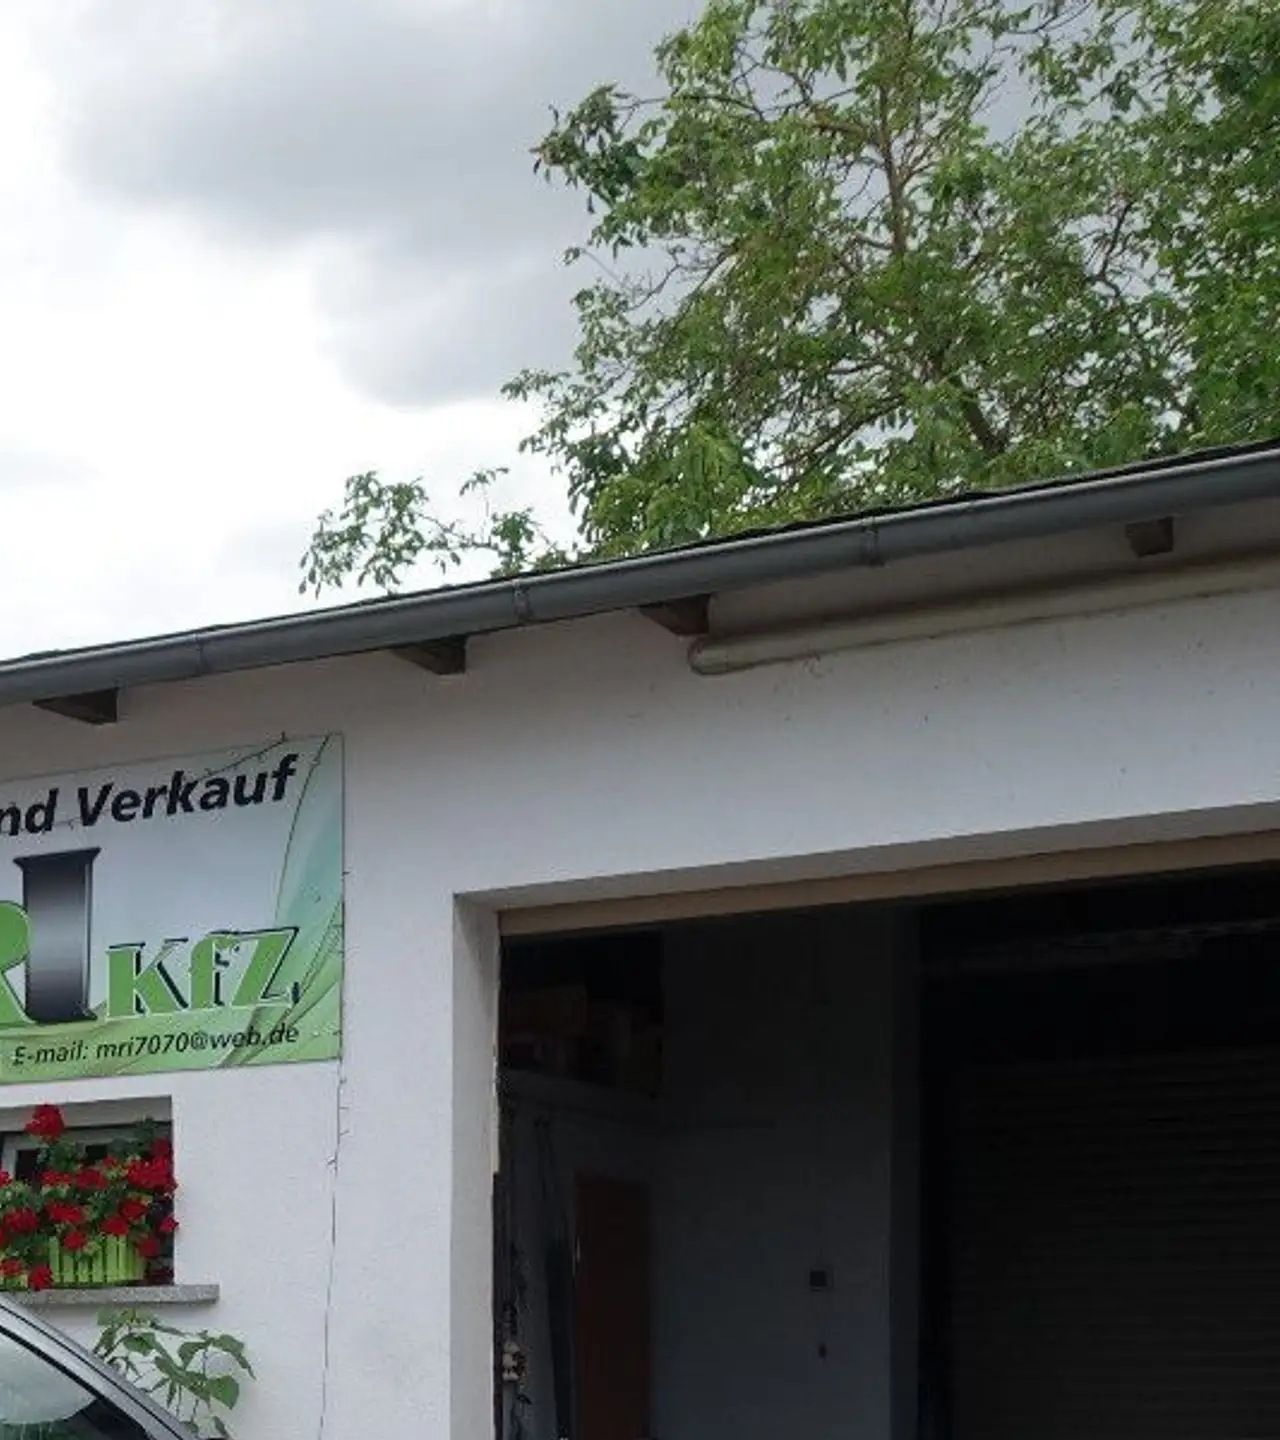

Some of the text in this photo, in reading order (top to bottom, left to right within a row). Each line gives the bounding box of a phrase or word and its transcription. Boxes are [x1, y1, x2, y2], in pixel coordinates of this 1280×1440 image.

[77, 752, 299, 828] Verkauf
[12, 1039, 89, 1067] E-mail:
[95, 1022, 300, 1060] mri7070@web.de
